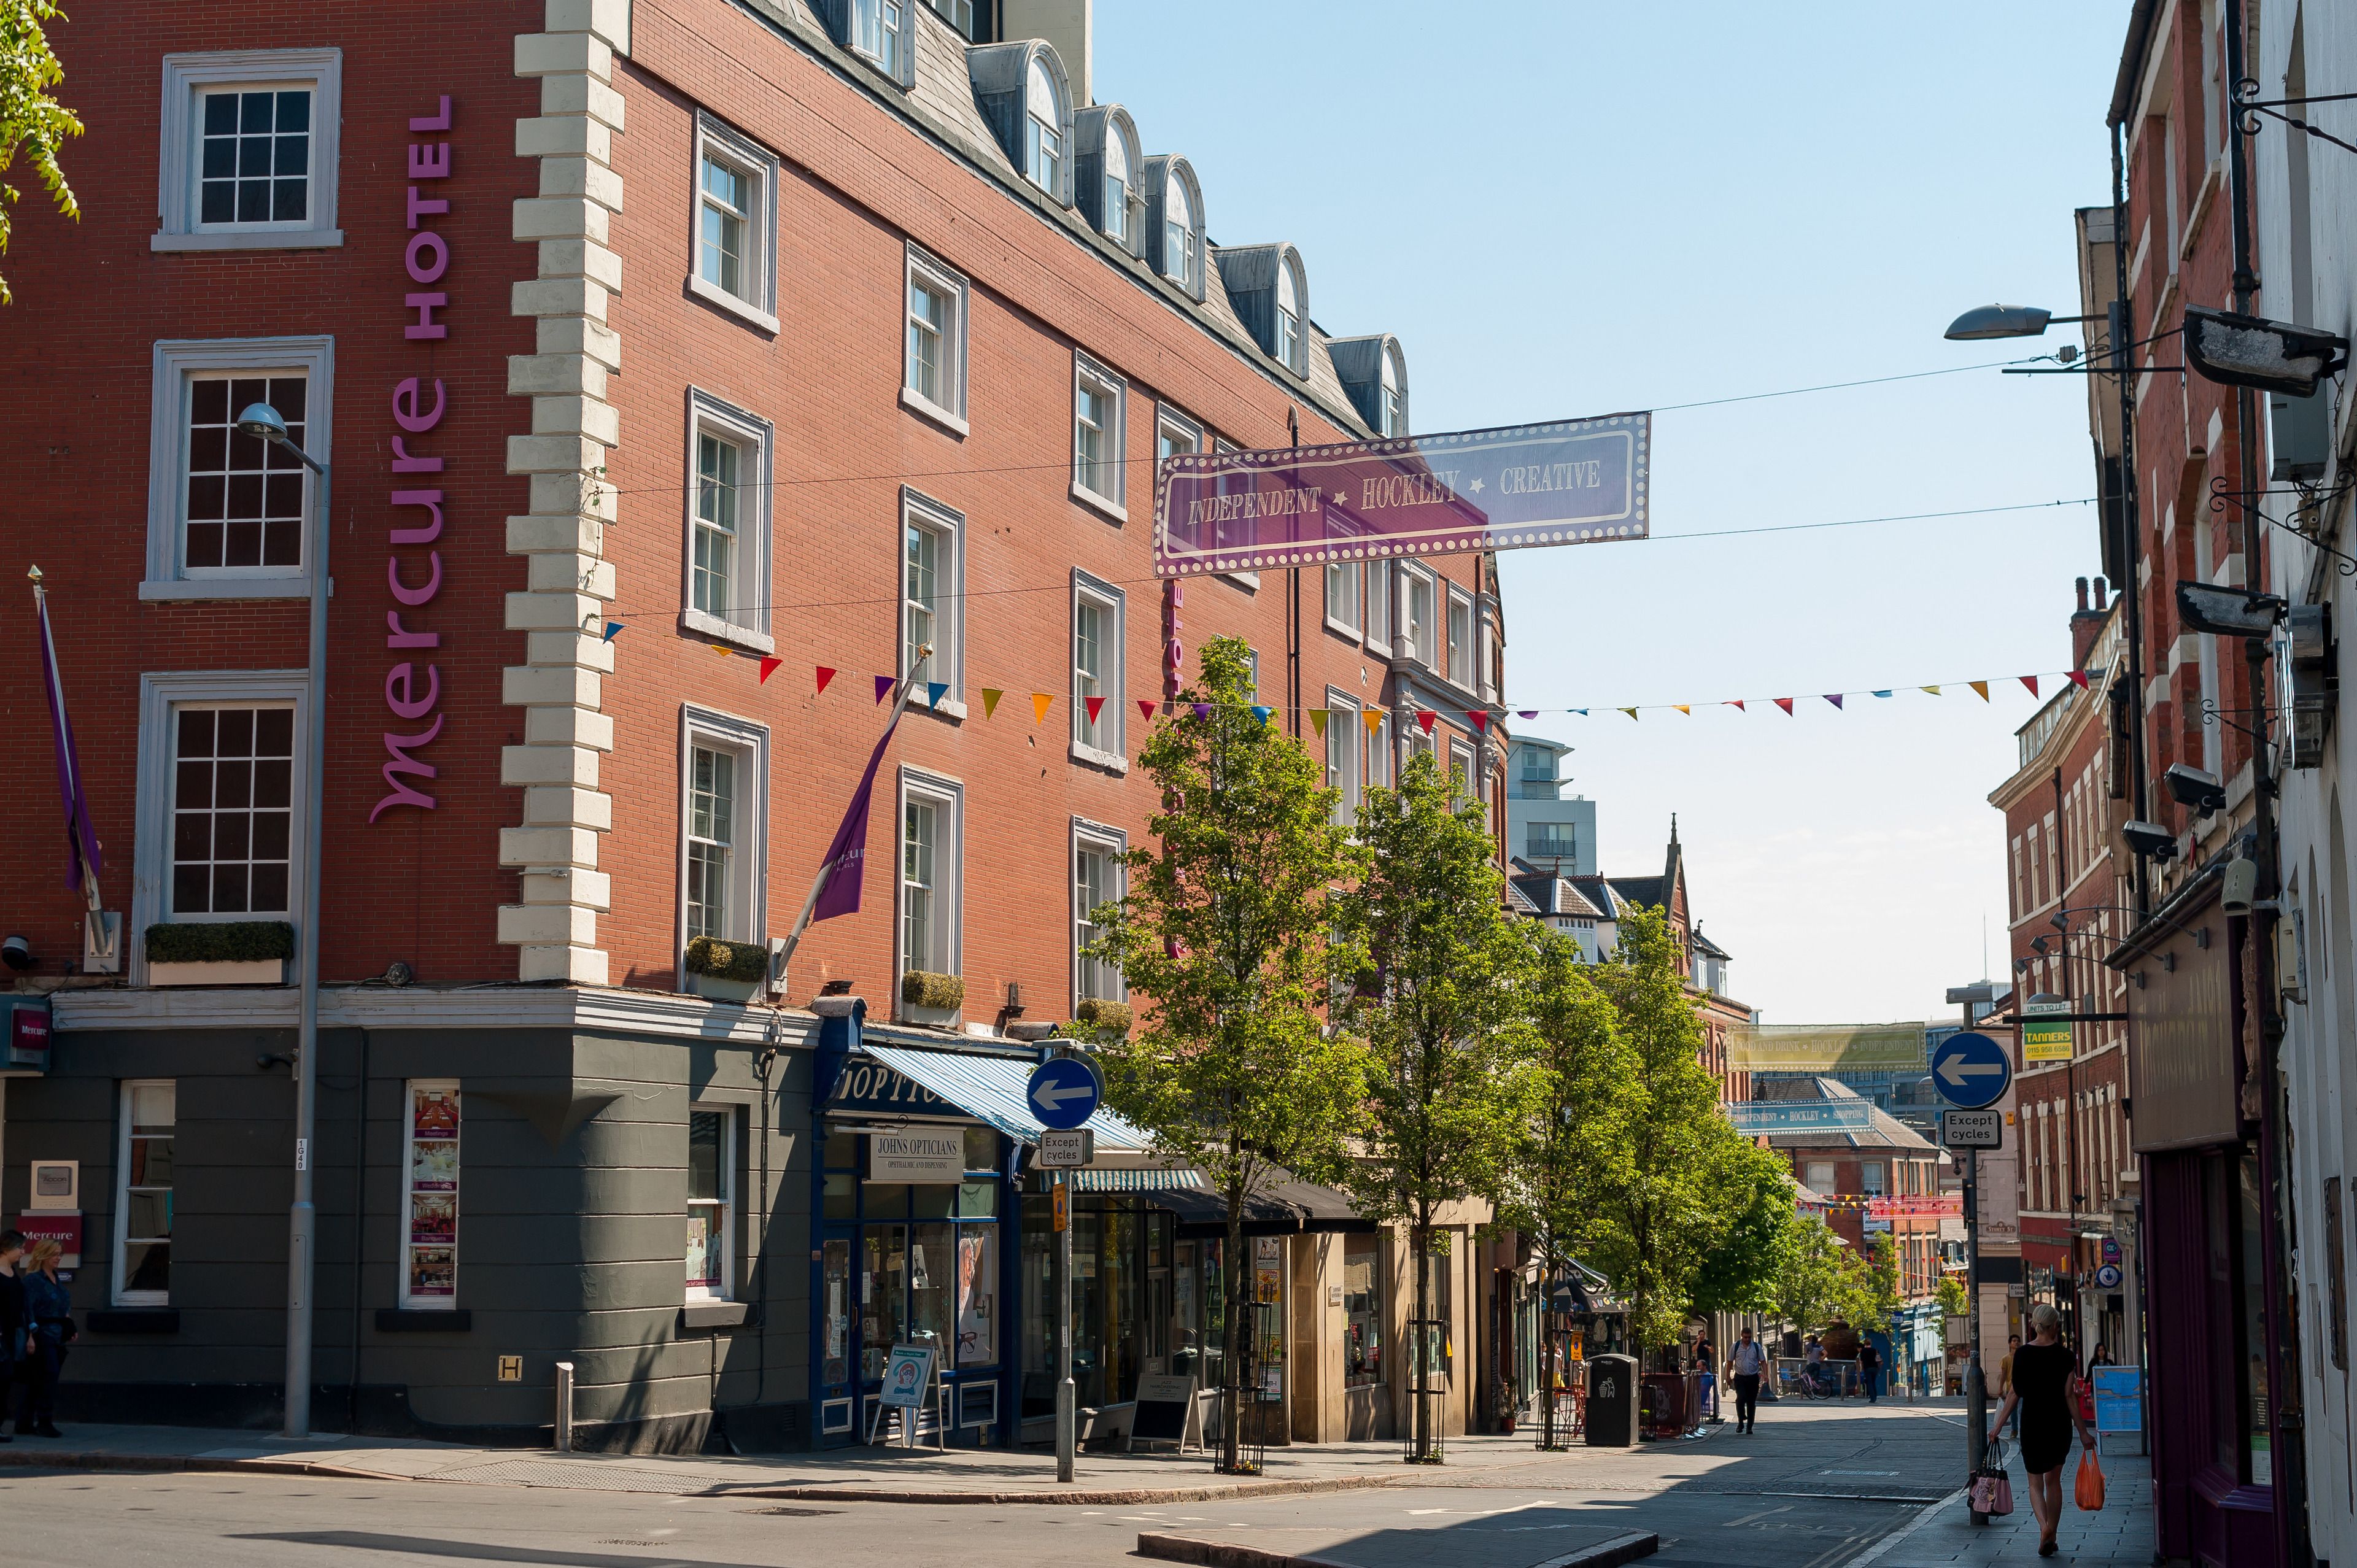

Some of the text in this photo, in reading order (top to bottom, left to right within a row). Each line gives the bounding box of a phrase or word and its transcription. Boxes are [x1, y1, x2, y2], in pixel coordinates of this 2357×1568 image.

[369, 95, 452, 824] mercure HOTEL
[1187, 459, 1601, 526] INDEPENDENT HOCKLEY CREATIVE
[1169, 577, 1183, 701] HOTE
[21, 1025, 47, 1036] Mercure
[2026, 1031, 2070, 1043] TANNERS
[1736, 1039, 1915, 1052] FOOD AND DRINK HOCKLEY INDEPENDENT
[1734, 1109, 1864, 1122] INDEPENDENT HOCKLEY SHOPPING
[1949, 1114, 1992, 1127] Except
[1952, 1129, 1991, 1140] cycles
[878, 1138, 957, 1156] JOHNS OPTICIANS
[1045, 1137, 1079, 1149] Except
[1047, 1149, 1077, 1161] cycles
[22, 1231, 74, 1240] Mercure
[502, 1358, 519, 1378] H
